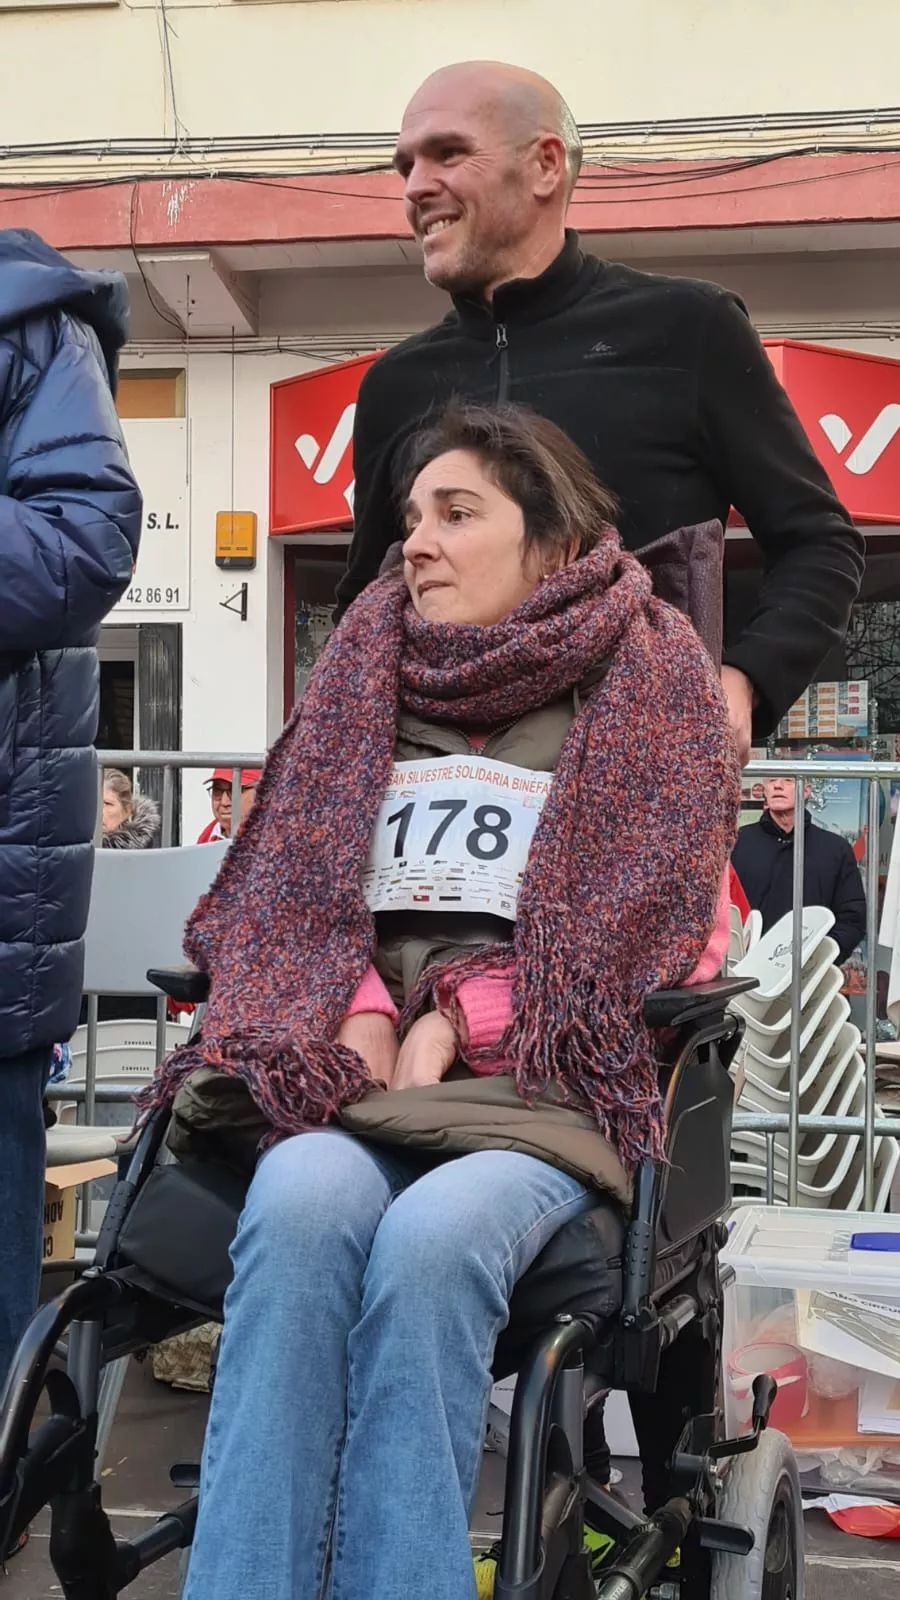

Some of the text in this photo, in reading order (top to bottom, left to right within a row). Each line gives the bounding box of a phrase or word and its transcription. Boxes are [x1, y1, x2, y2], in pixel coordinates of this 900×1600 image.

[147, 513, 180, 529] S. L.
[127, 588, 180, 603] 42 86 91
[387, 765, 551, 795] SAN SILVESTRE SOLIDARIA BINÉFA
[386, 799, 512, 861] 178
